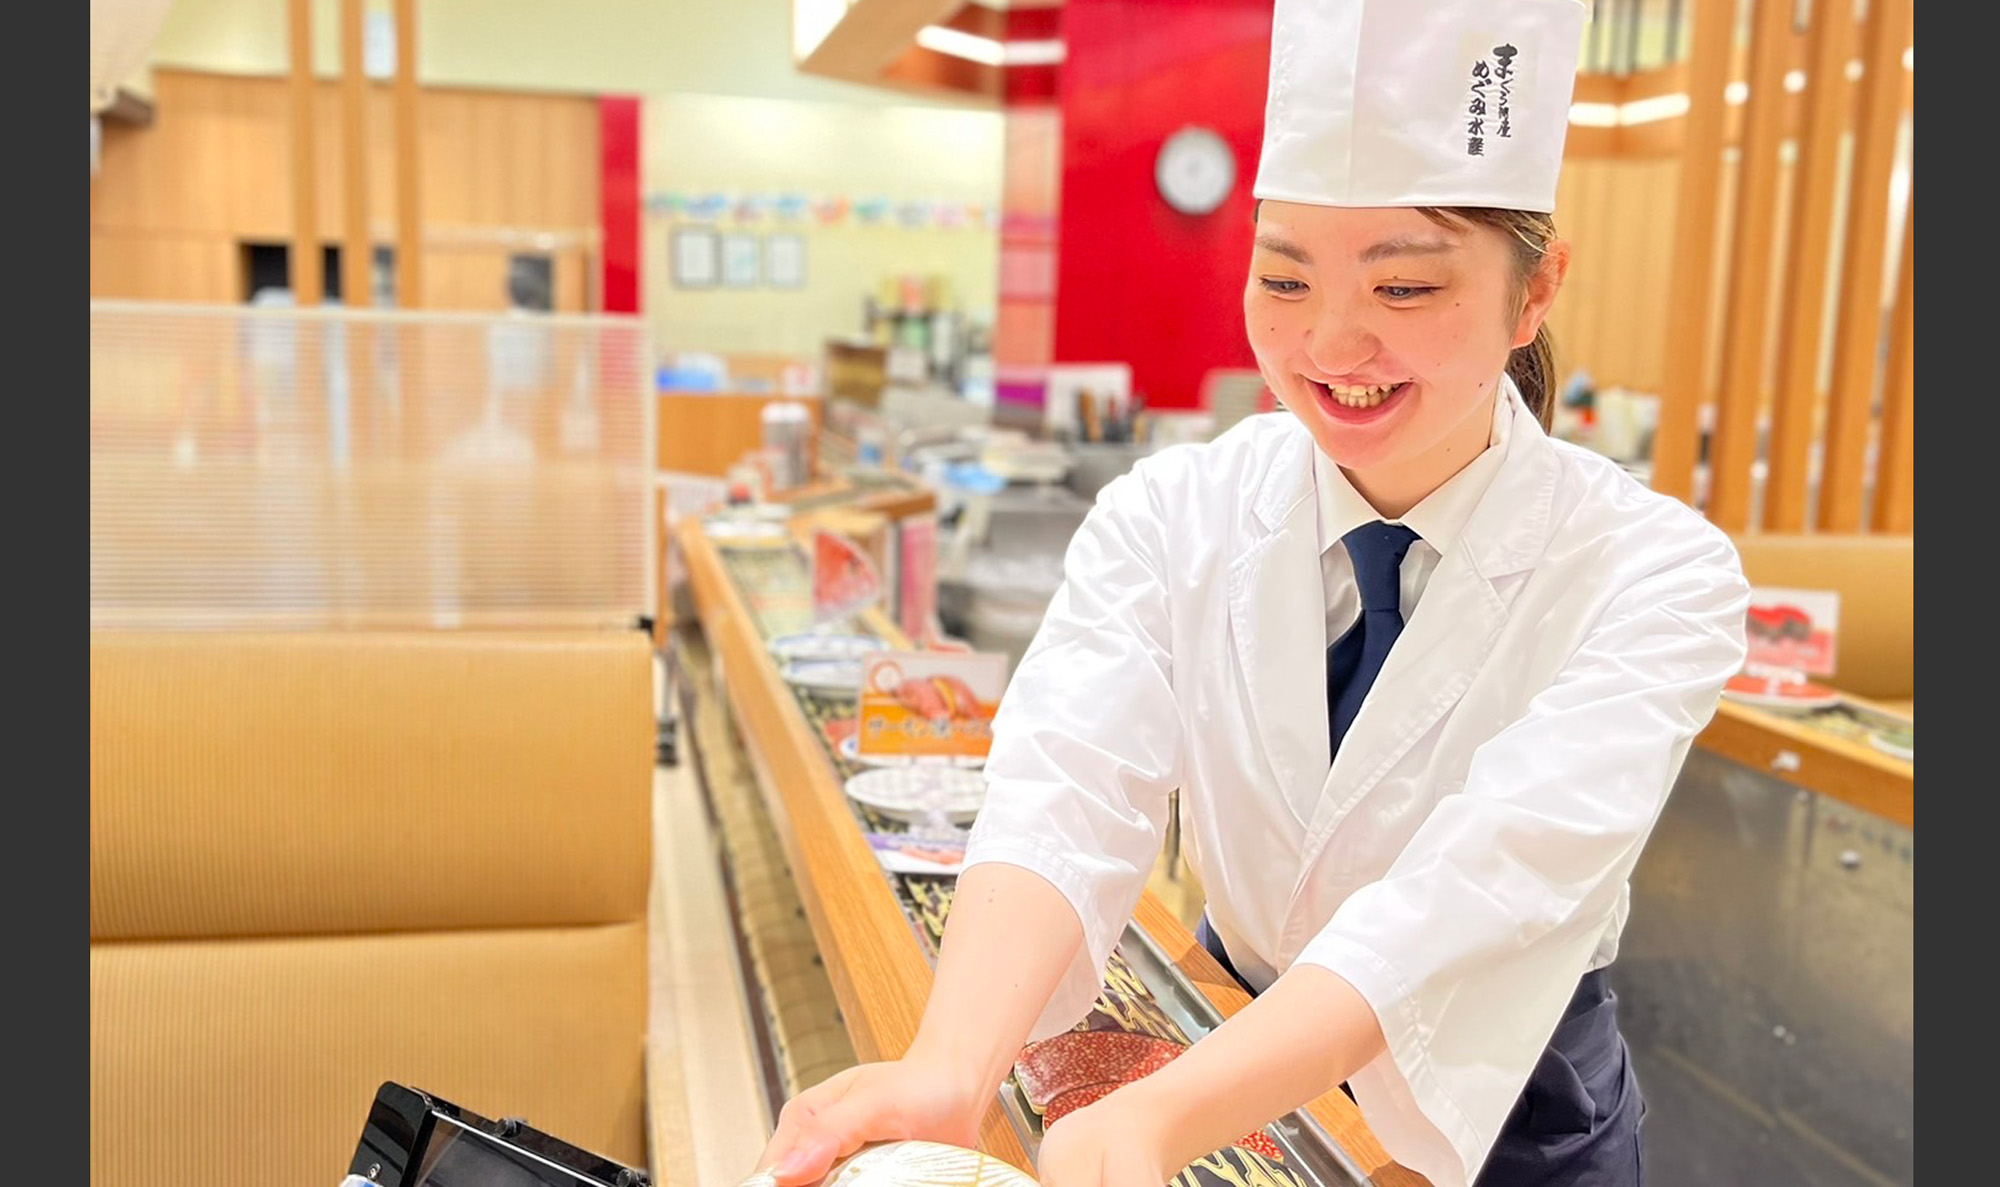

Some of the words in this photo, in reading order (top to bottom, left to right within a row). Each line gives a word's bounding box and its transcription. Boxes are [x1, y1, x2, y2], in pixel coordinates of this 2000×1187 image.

[1467, 60, 1492, 156] めぐみ水産
